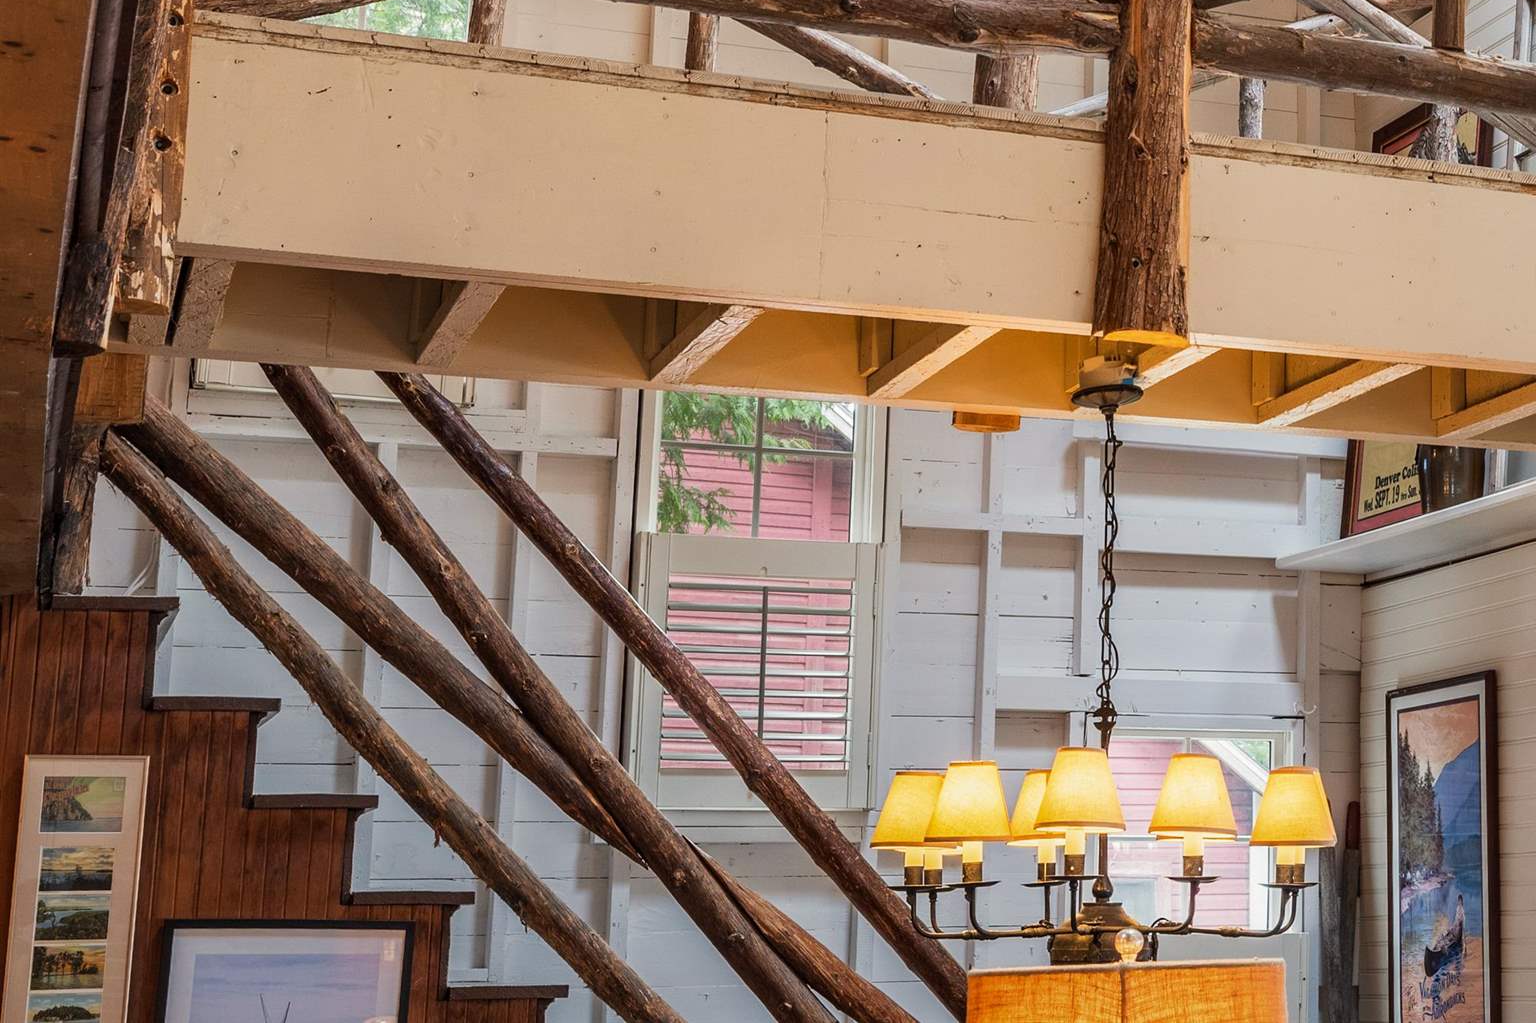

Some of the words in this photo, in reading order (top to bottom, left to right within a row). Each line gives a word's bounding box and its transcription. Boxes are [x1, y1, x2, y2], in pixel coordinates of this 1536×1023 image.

[1375, 472, 1401, 489] Denver
[1375, 488, 1391, 509] SEPT.
[1392, 484, 1400, 503] 19
